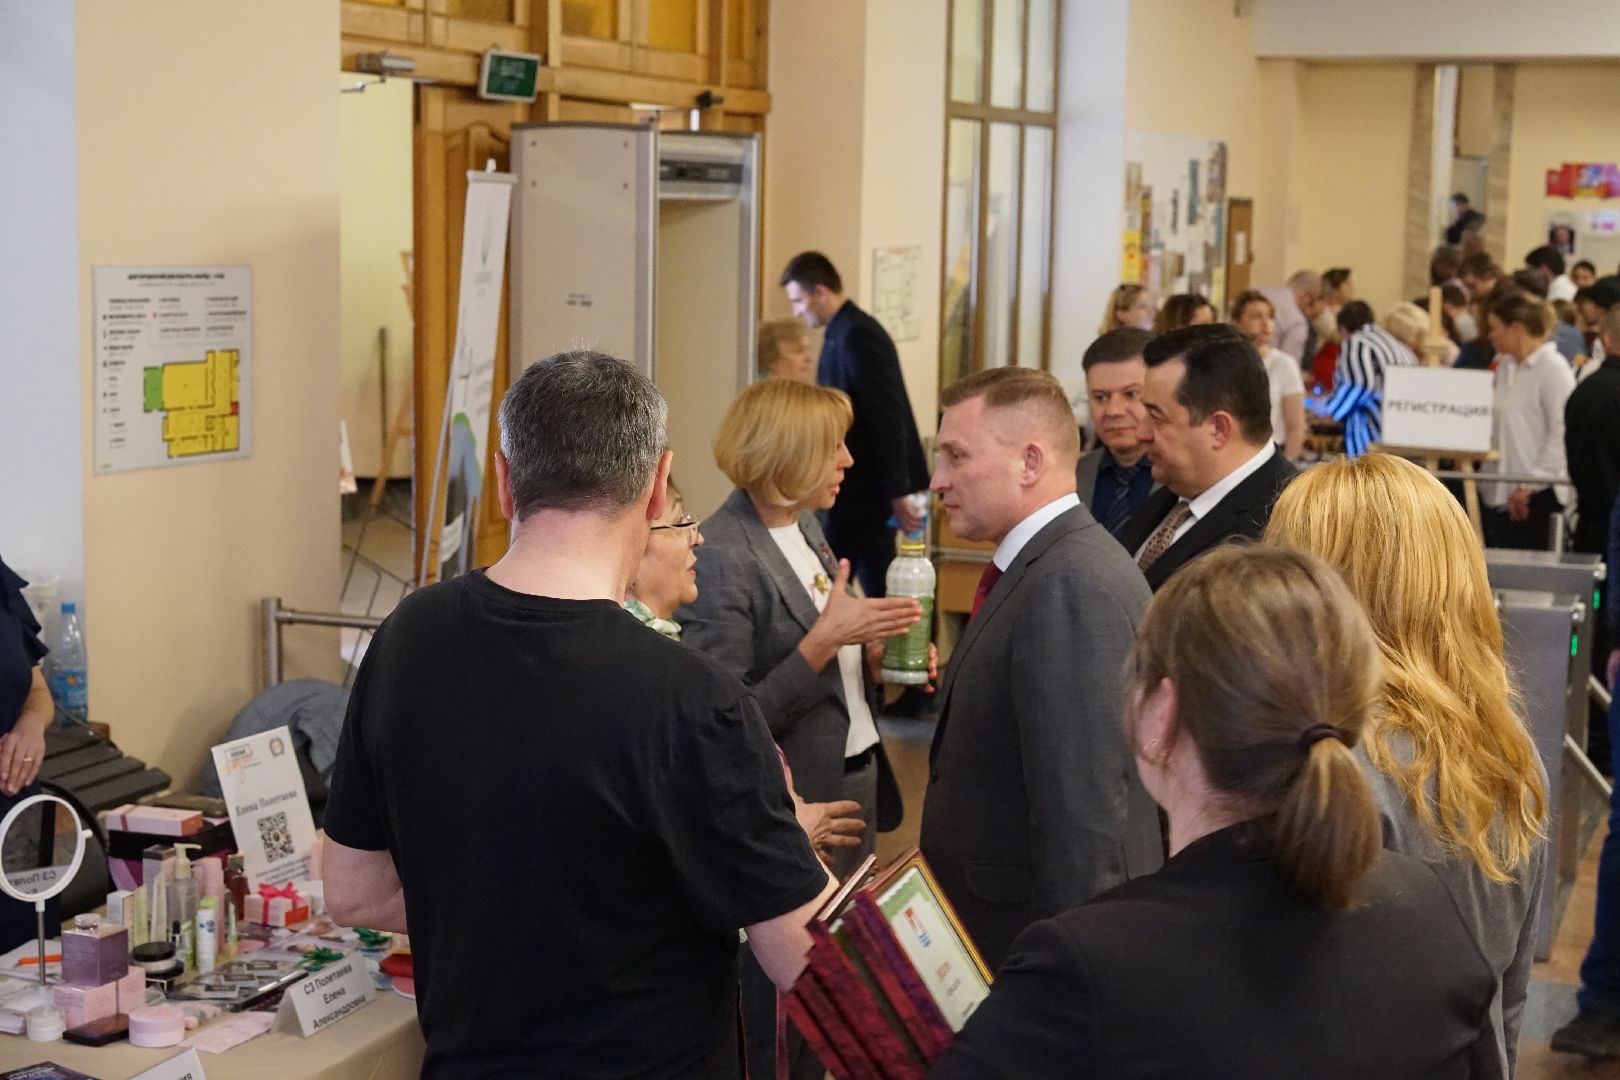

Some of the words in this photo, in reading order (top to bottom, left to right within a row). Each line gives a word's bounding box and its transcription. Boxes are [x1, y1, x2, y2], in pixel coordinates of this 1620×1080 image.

[1387, 400, 1488, 417] РЕГИСТРАЦИЯ
[235, 803, 258, 816] Елена
[315, 964, 352, 988] Полетаева
[323, 987, 346, 1004] Елена
[313, 995, 366, 1029] Александровна
